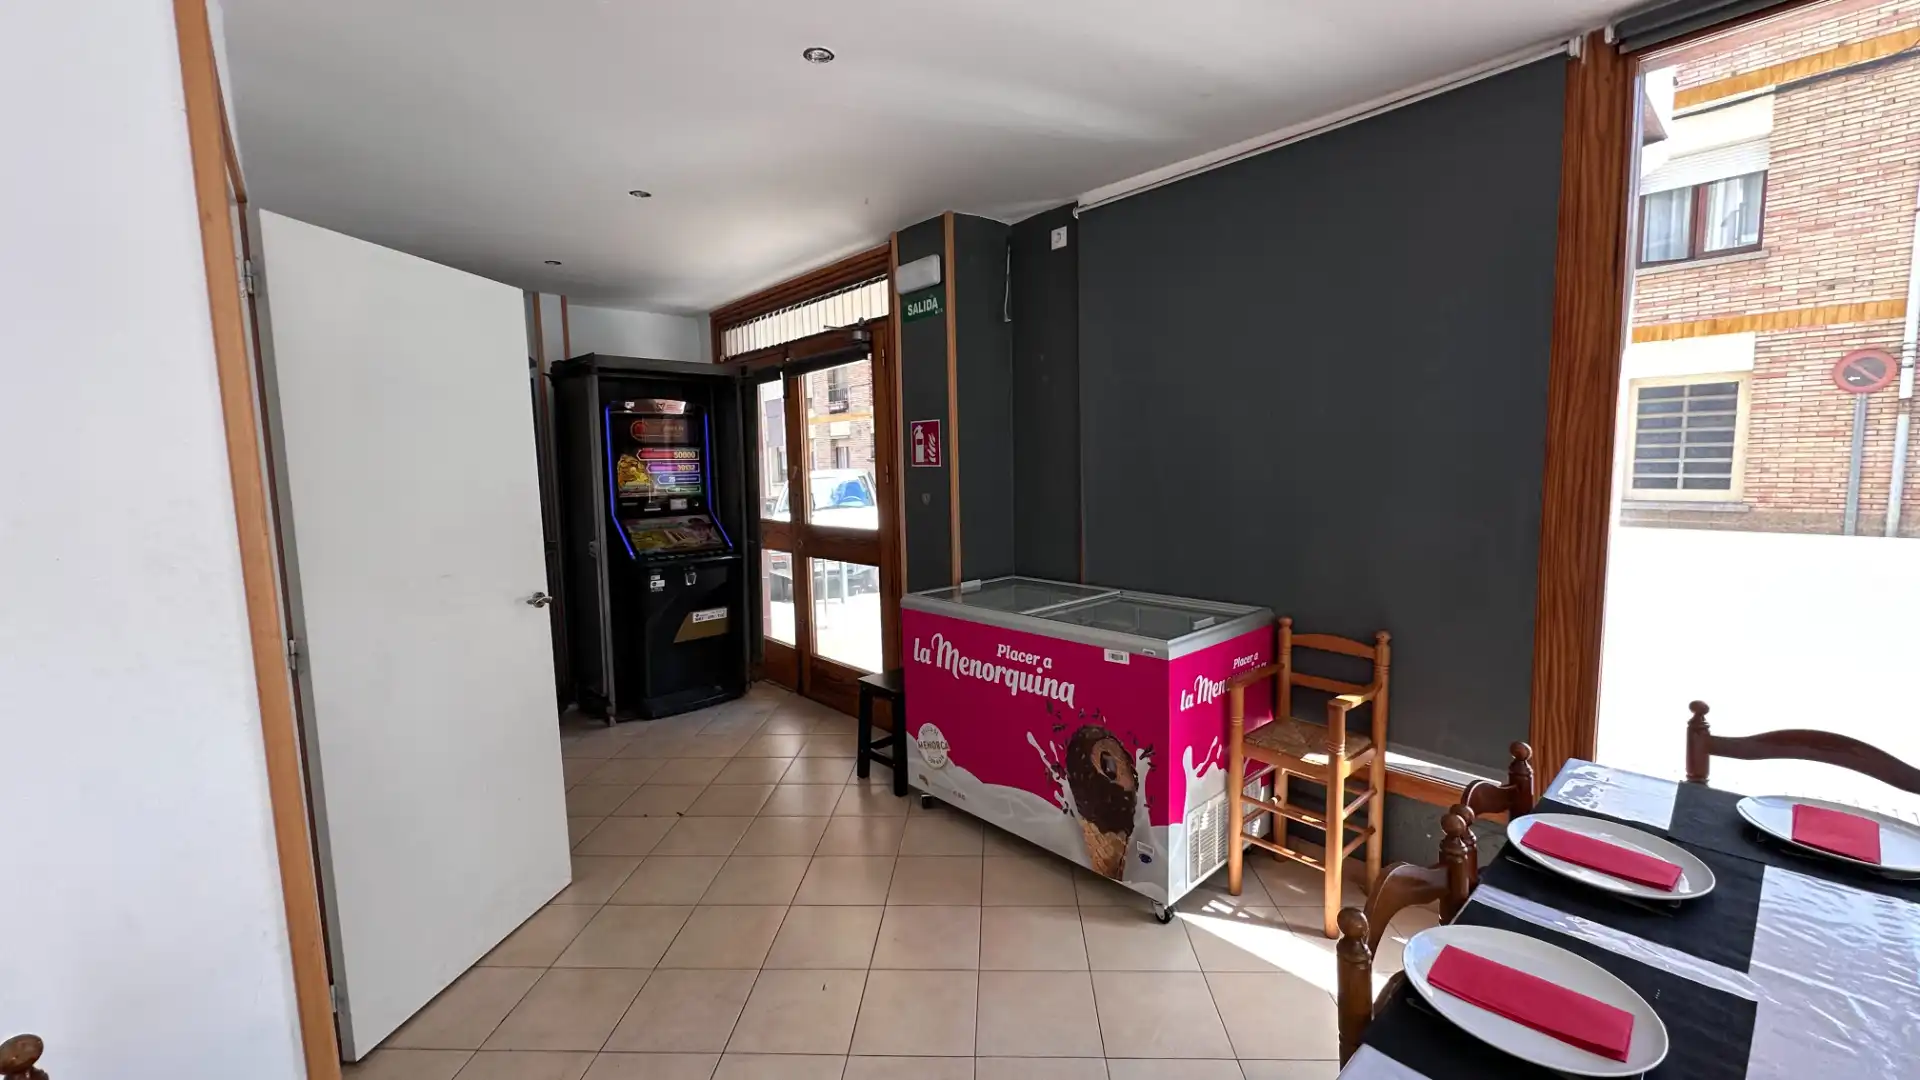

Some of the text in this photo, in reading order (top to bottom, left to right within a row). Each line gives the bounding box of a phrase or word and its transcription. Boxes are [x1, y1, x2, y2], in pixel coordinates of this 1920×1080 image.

[907, 297, 939, 316] SALIDA
[996, 643, 1053, 669] Placer a
[1232, 652, 1259, 669] Placer a
[913, 632, 1076, 709] la Menorquina
[1180, 689, 1194, 712] la
